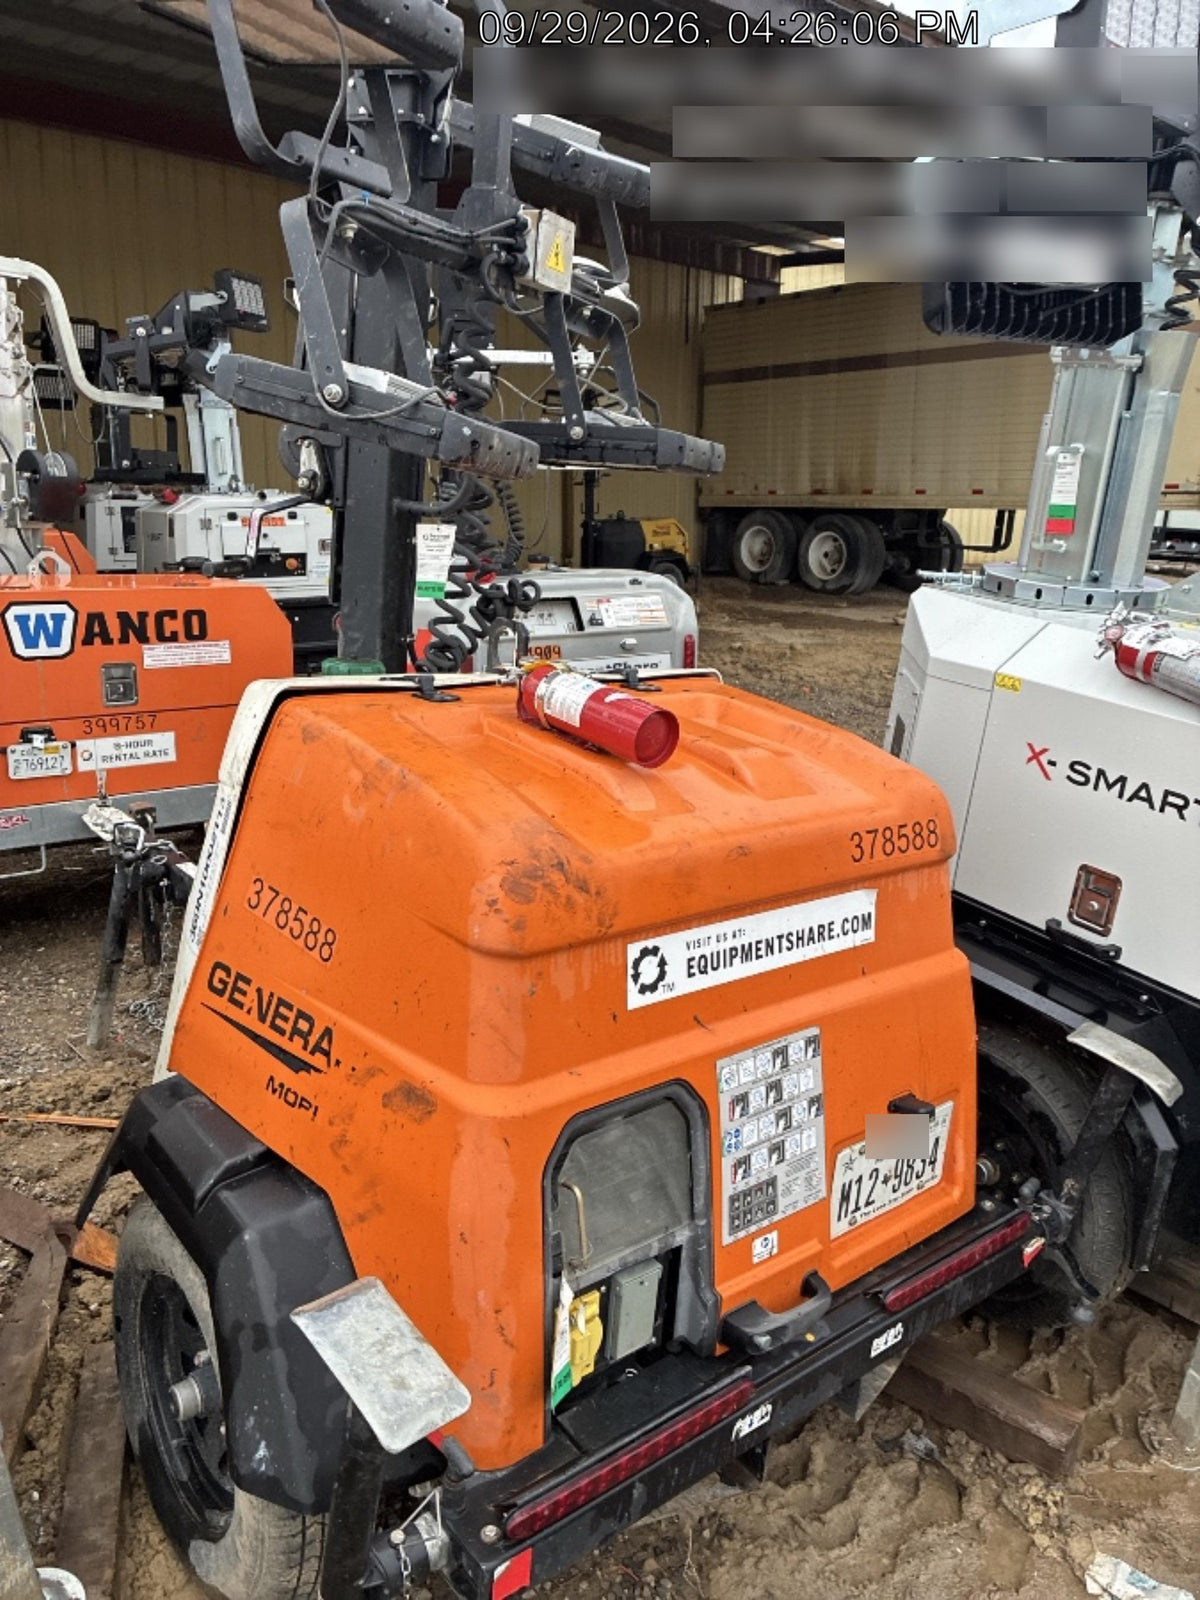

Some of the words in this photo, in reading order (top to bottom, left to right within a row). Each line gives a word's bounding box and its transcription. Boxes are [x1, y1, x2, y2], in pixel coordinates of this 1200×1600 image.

[14, 609, 208, 650] WANCO
[83, 714, 158, 735] 399757
[102, 752, 141, 763] RENTAL
[143, 749, 170, 760] RATE
[1066, 760, 1200, 822] SMAR
[850, 819, 939, 863] 378588
[247, 878, 337, 962] 378588
[686, 935, 712, 951] VISIT
[716, 932, 728, 944] US
[732, 928, 746, 940] AT:
[686, 911, 873, 979] EQUIPMENTSHARE.COM
[662, 982, 675, 994] TM
